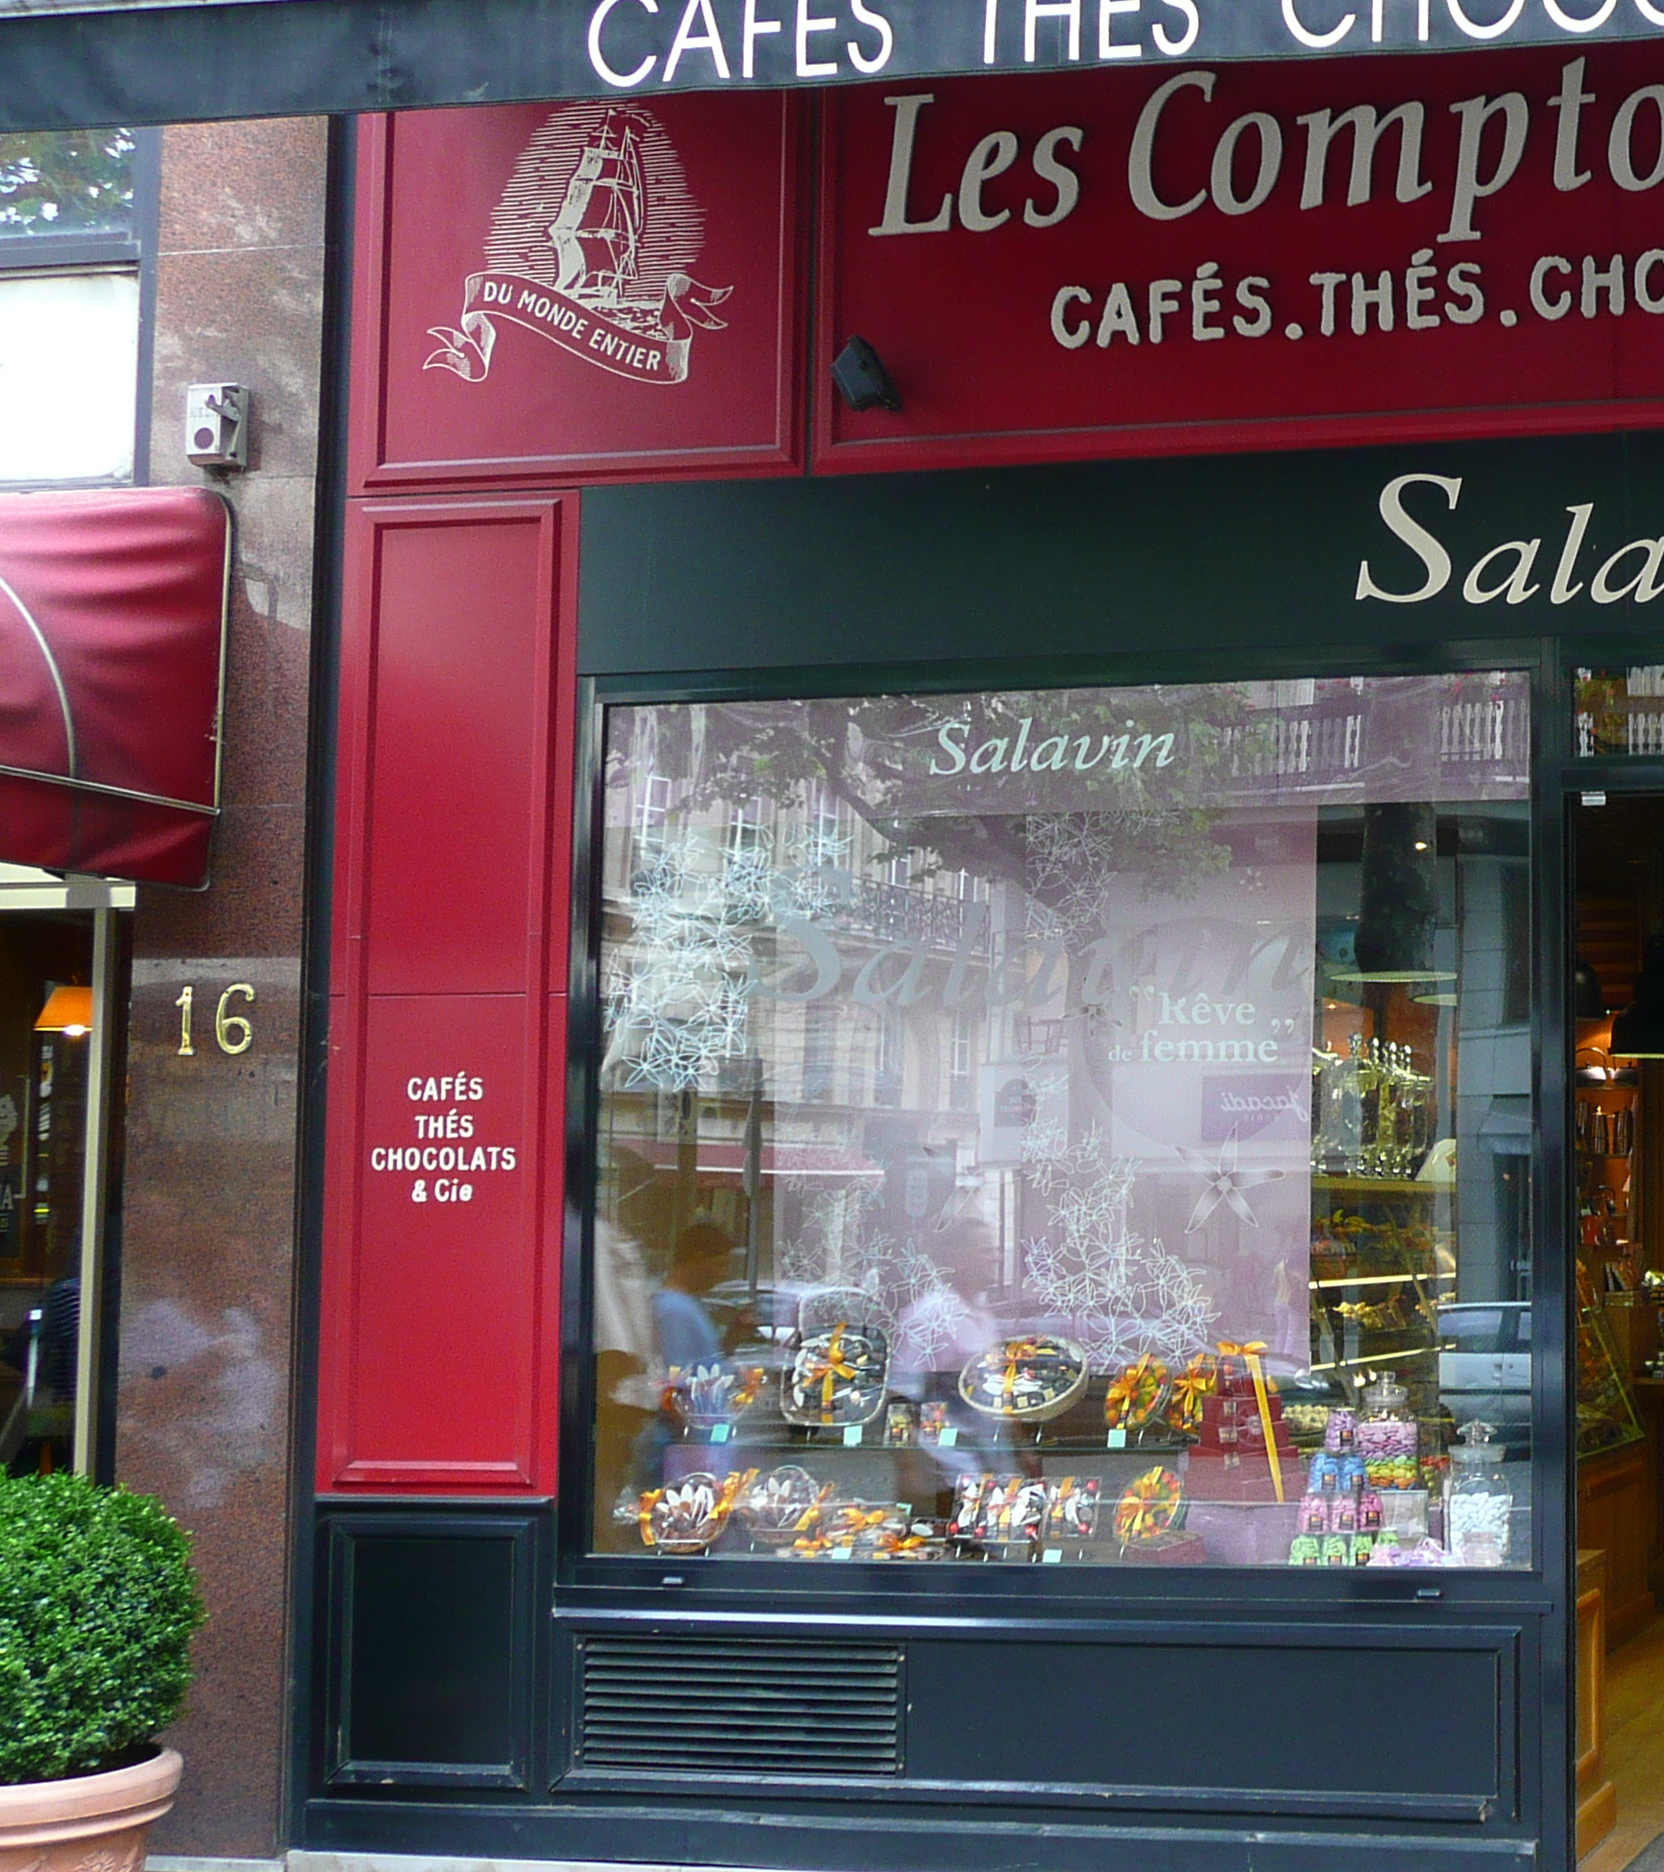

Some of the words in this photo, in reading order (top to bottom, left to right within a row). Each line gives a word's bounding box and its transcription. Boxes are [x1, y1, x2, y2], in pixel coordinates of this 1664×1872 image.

[867, 93, 1083, 236] Les
[483, 281, 514, 304] DU
[516, 289, 590, 340] MONDE
[588, 327, 662, 371] ENTIER
[929, 718, 1176, 777] Salavin
[175, 983, 255, 1056] 16
[1108, 1044, 1132, 1063] de
[1139, 1029, 1279, 1063] femme
[407, 1070, 484, 1102] CAFÉS
[414, 1109, 474, 1139] THÉS
[371, 1146, 516, 1172] CHOCOLATS
[411, 1179, 428, 1203] &
[434, 1178, 473, 1203] Cie
